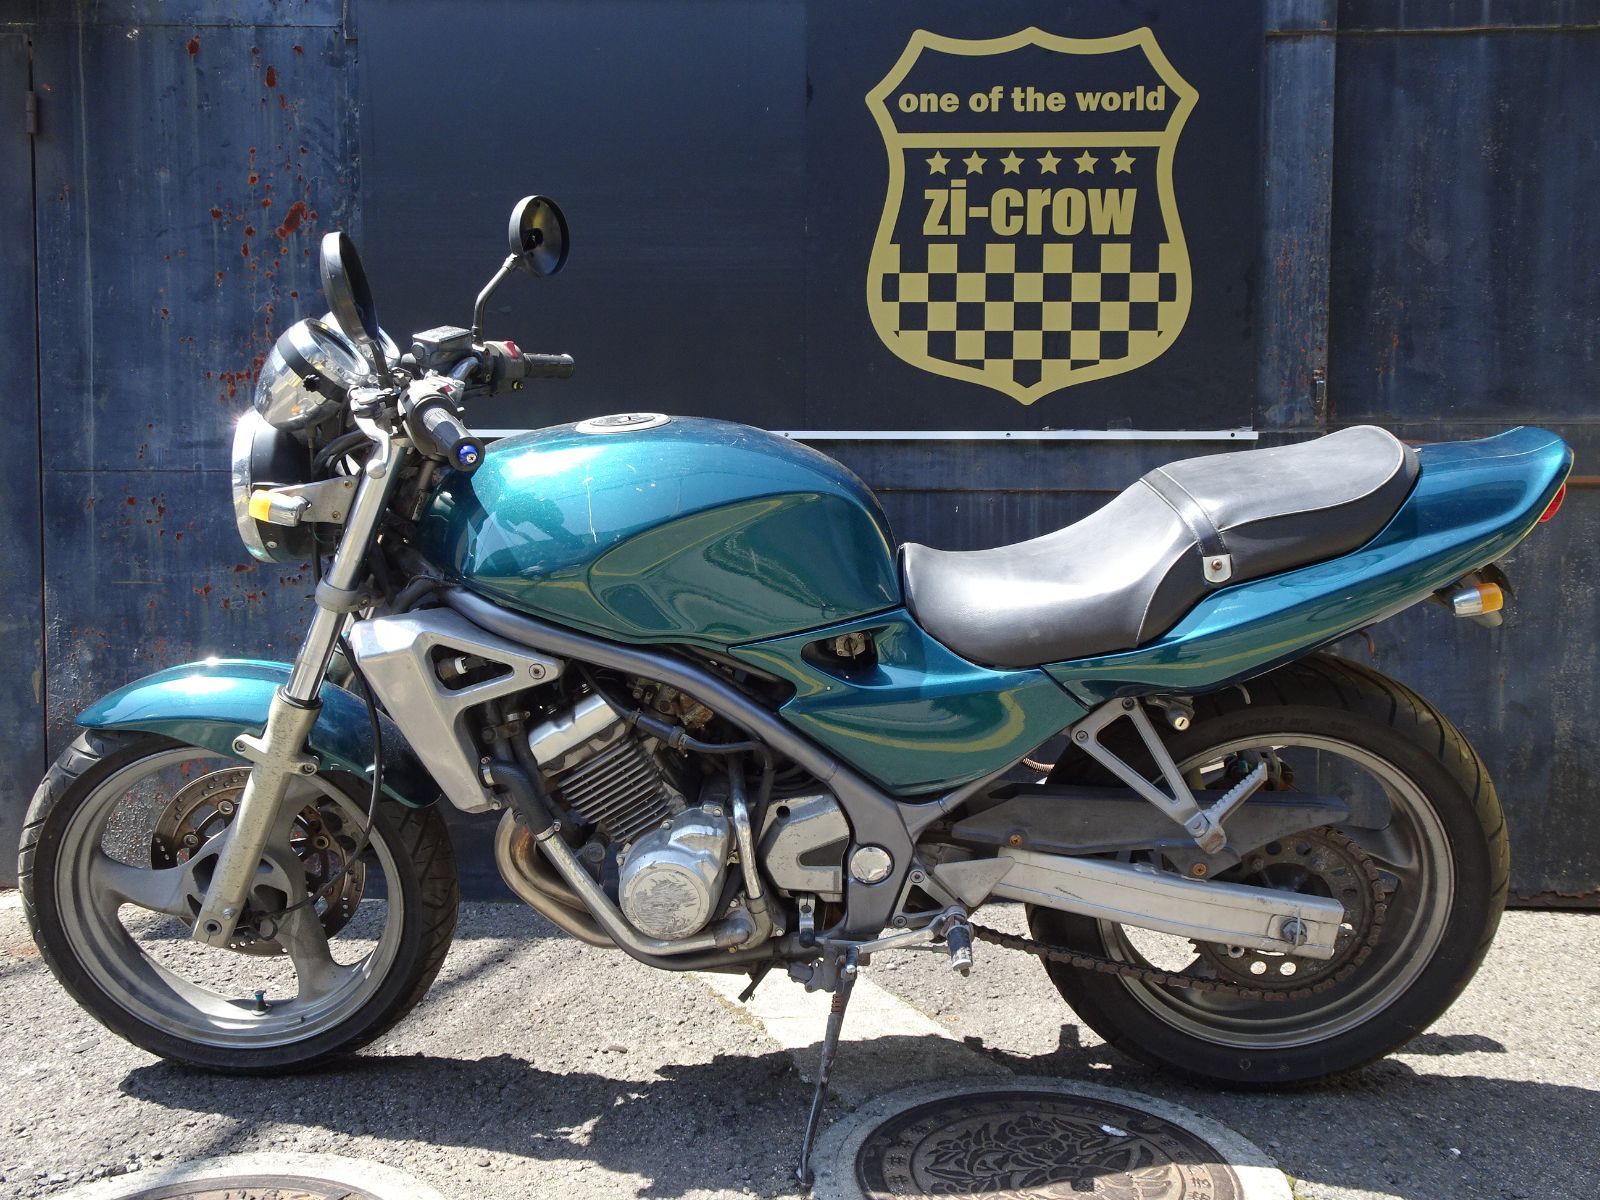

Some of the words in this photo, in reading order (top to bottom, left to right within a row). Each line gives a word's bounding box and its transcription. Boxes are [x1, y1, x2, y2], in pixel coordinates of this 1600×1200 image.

[898, 92, 960, 113] one
[969, 85, 1004, 112] of
[1011, 86, 1067, 112] the
[1075, 85, 1166, 112] world
[922, 179, 1137, 236] zi-crow
